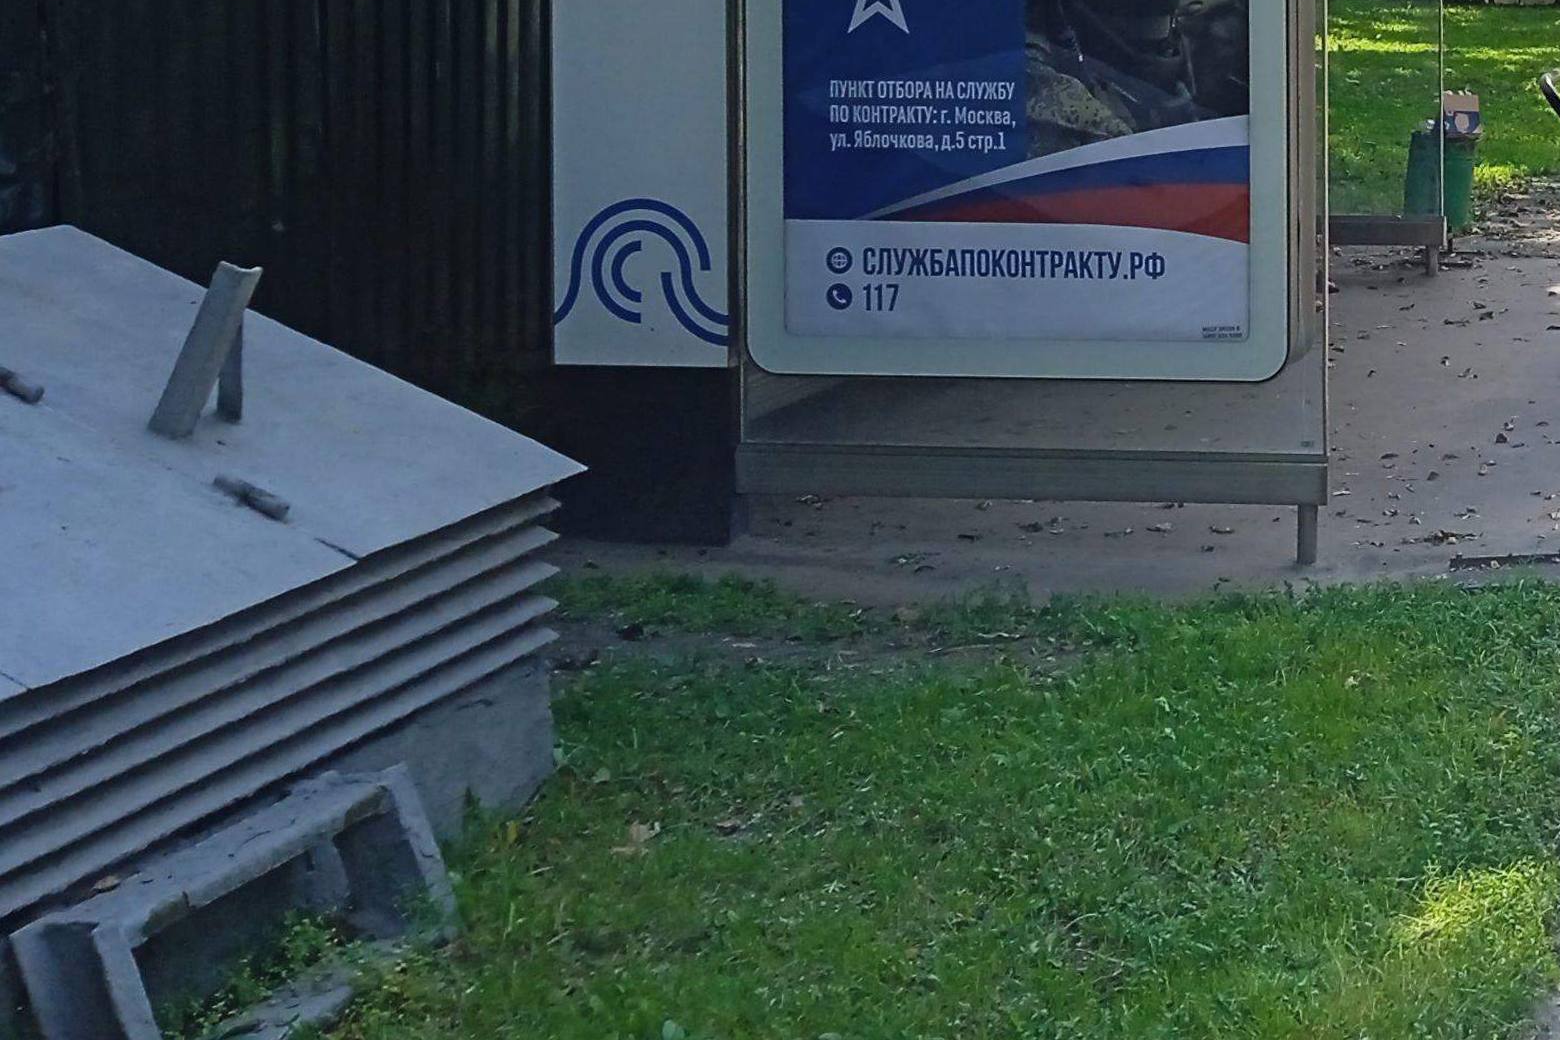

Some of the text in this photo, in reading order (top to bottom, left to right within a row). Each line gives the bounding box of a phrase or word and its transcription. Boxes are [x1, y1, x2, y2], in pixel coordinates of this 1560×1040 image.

[829, 79, 1015, 100] ПУНКТ ОТБОРА НА СЛУЖБУ
[829, 104, 1017, 128] ПО КОНТРАКТУ: г. Москва,
[829, 132, 851, 151] ул.
[967, 131, 1007, 153] стр.1
[862, 246, 1166, 281] СЛУЖБАПОКОНТРАКТУ.РФ
[862, 283, 900, 312] 117
